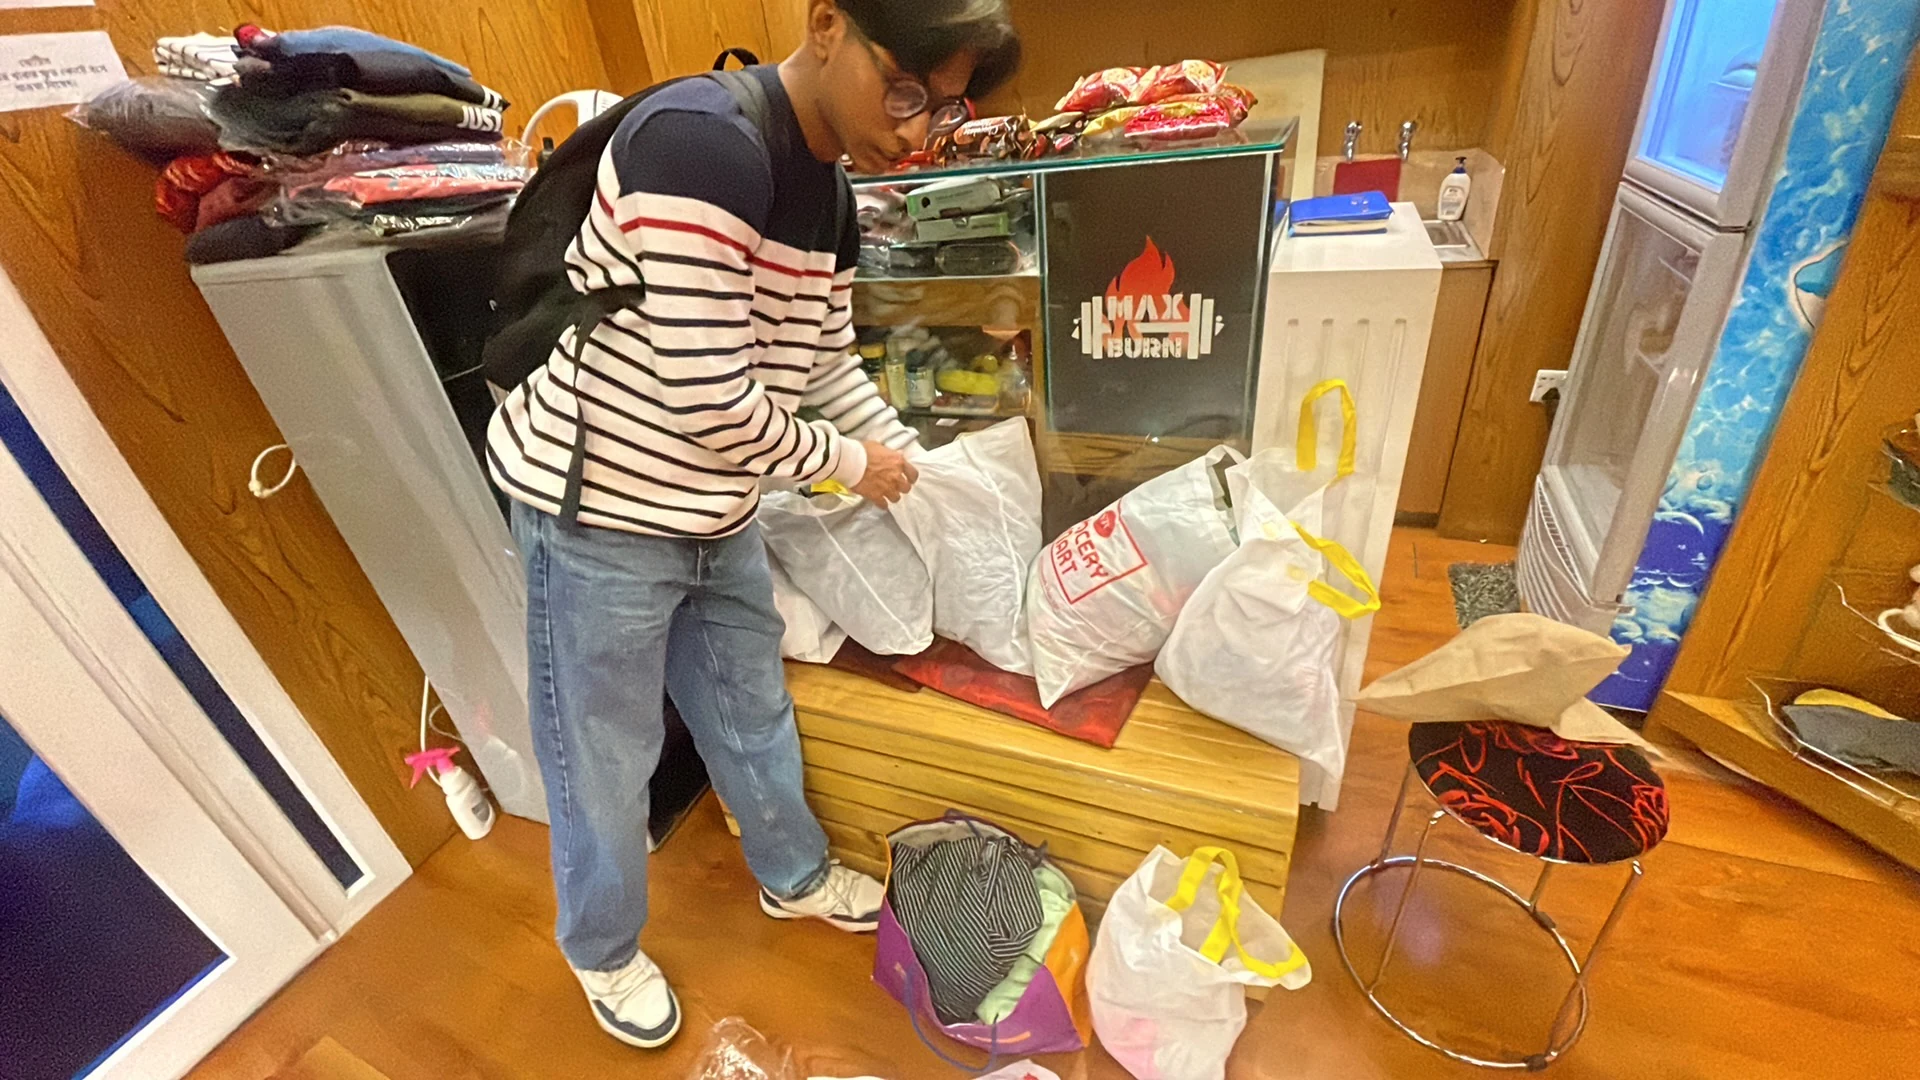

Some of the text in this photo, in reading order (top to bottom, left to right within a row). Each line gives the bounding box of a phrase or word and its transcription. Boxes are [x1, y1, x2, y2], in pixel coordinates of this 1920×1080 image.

[457, 105, 502, 132] JUST
[1107, 294, 1184, 320] MAX
[1107, 337, 1182, 359] BURN
[1074, 520, 1109, 578] OCERY
